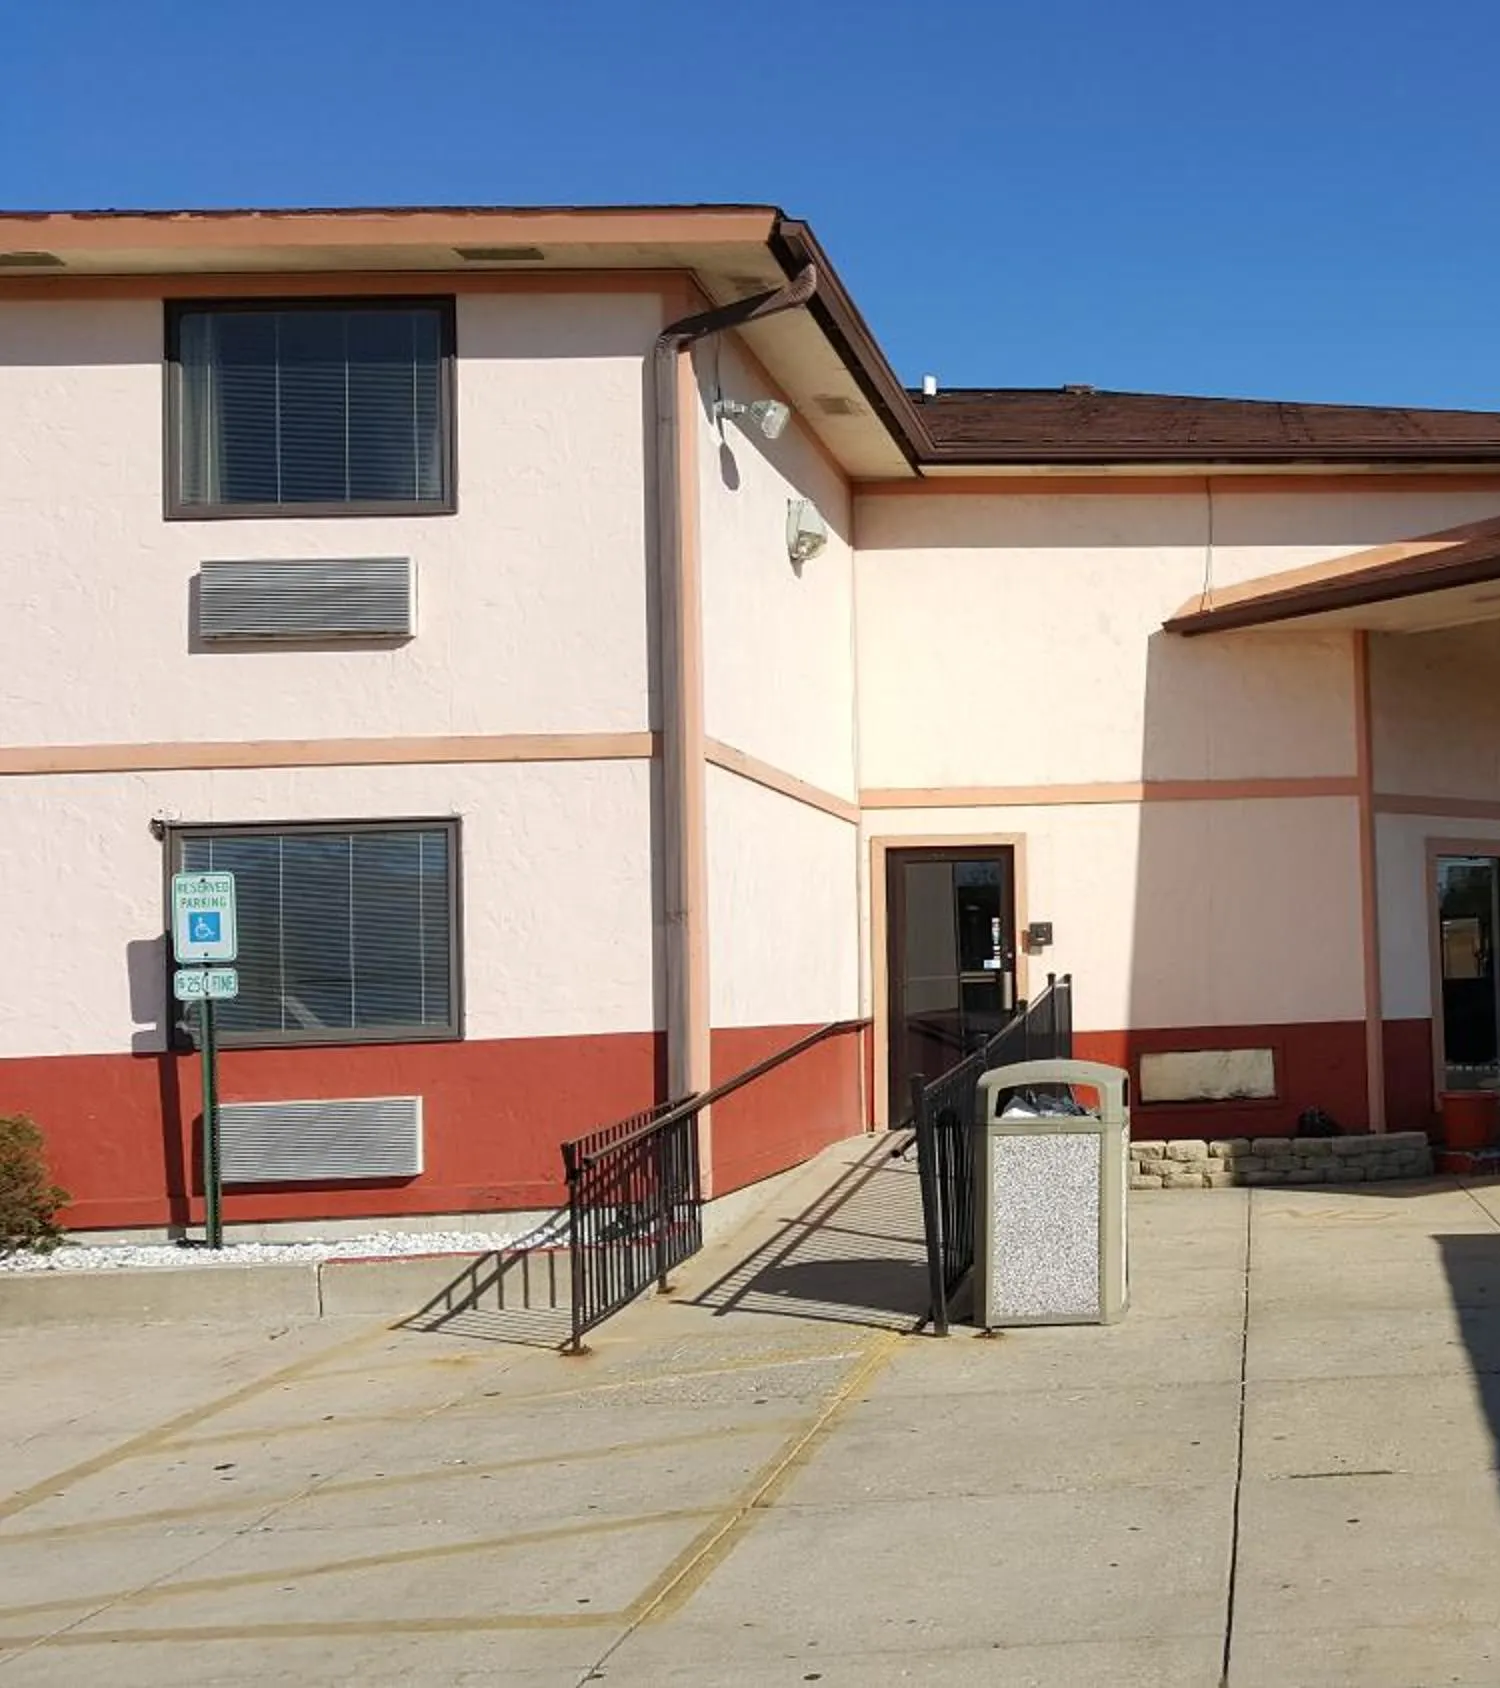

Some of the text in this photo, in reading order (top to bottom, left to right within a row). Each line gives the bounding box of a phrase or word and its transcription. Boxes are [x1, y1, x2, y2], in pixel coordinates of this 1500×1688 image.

[177, 881, 229, 894] RESERVED
[180, 897, 227, 908] PARKING
[212, 975, 234, 992] FINE
